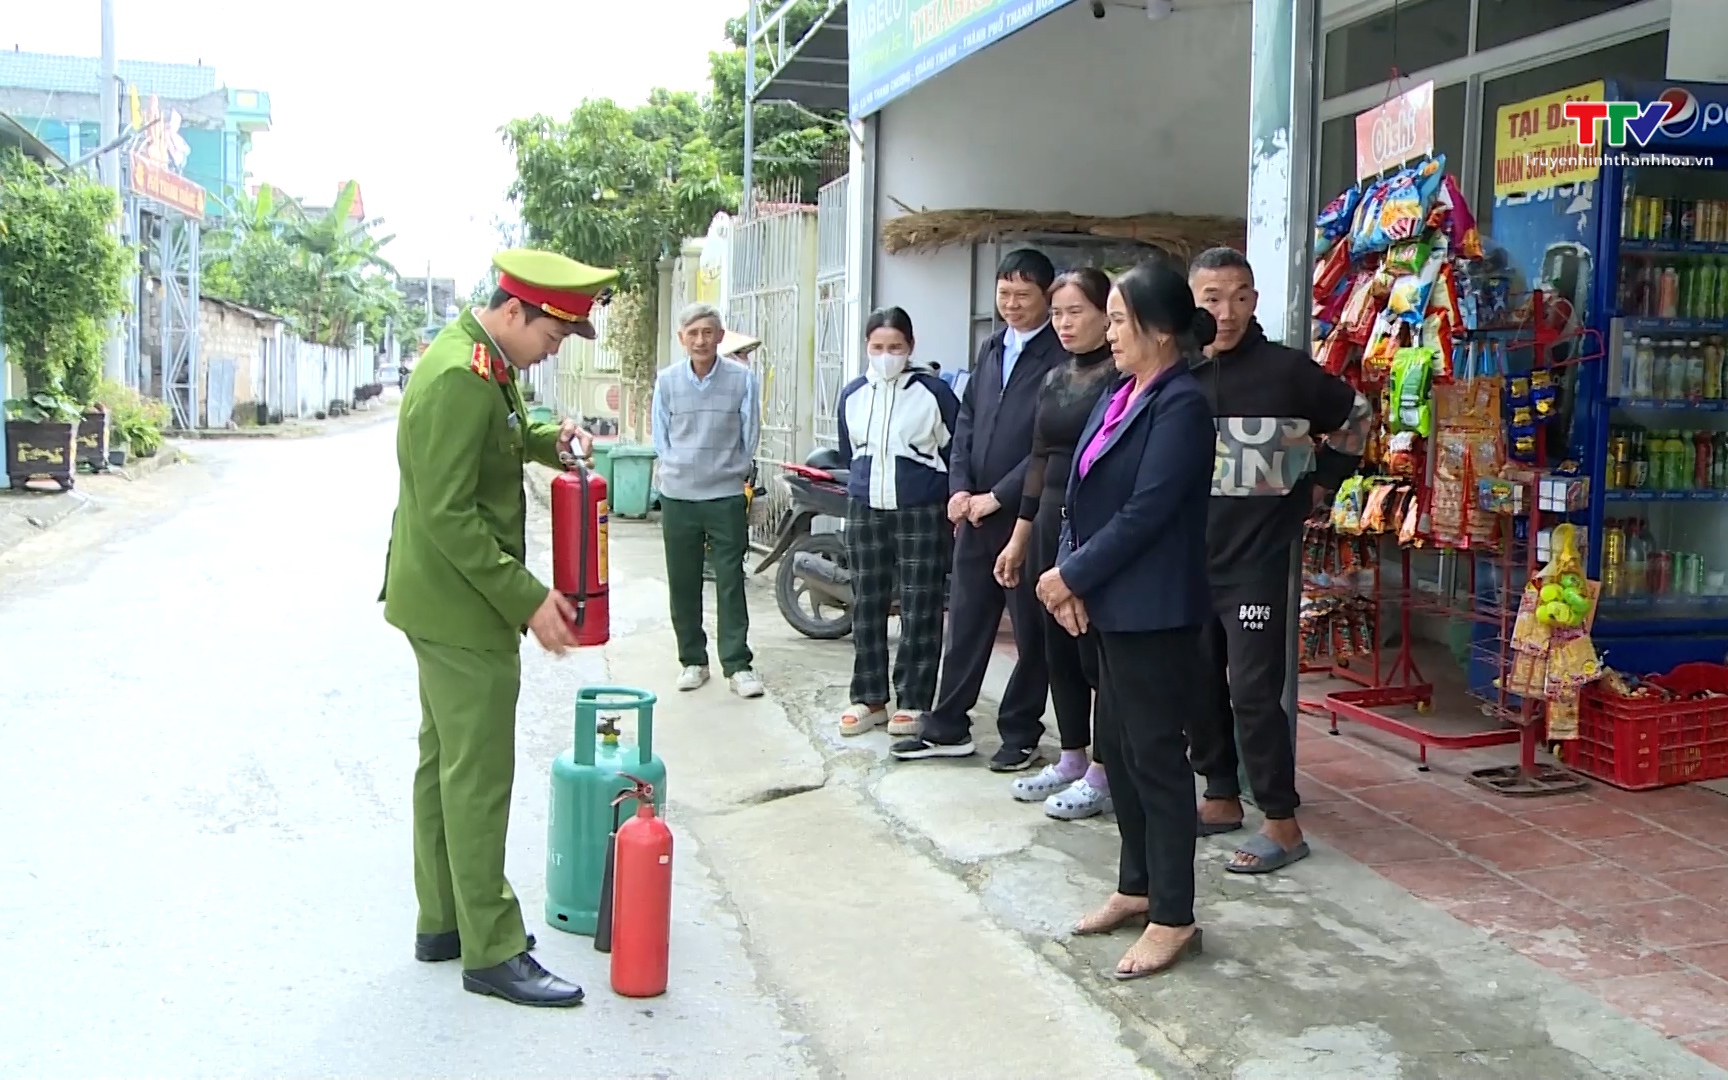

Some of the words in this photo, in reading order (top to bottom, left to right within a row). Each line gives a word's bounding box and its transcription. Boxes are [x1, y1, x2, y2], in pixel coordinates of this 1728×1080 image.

[988, 11, 1004, 37] PHỐ
[1006, 2, 1033, 27] THANH
[1508, 108, 1539, 141] TẠI
[1239, 604, 1271, 620] BOYS
[1243, 621, 1264, 630] FOR
